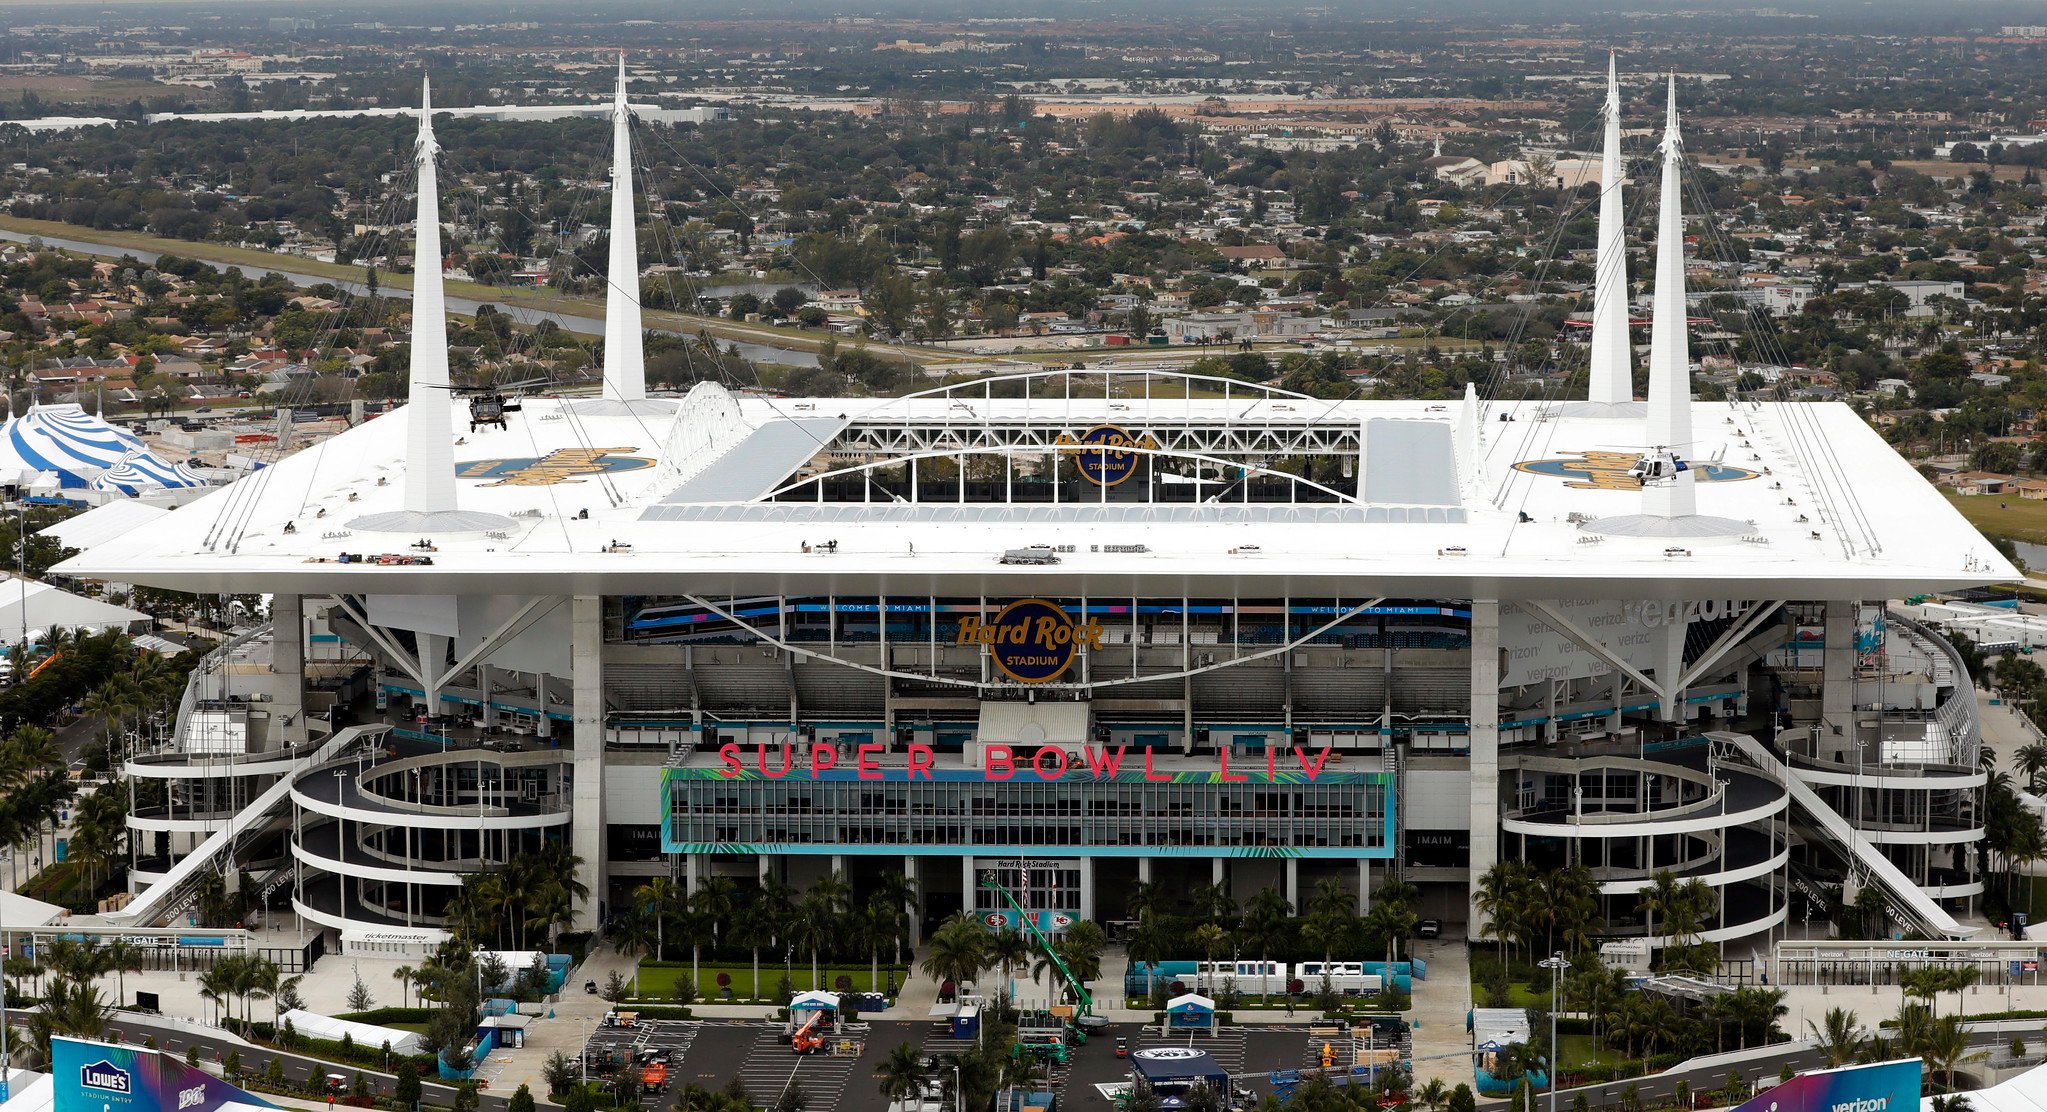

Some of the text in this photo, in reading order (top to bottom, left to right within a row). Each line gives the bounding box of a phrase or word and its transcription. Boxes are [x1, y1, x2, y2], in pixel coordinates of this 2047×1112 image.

[1055, 434, 1106, 455] Hard
[1088, 463, 1125, 471] STADIUM
[820, 604, 870, 612] WLCOME
[894, 604, 926, 612] MIAMI
[957, 616, 1104, 651] Hard Rock
[1510, 646, 1538, 660] rizon
[1006, 656, 1058, 666] STADIUM
[1526, 665, 1568, 681] verizon
[719, 742, 1331, 782] SUPER BOWL LIV
[997, 860, 1014, 868] Hard
[1031, 860, 1060, 868] Stadium
[1794, 878, 1827, 912] 200 LEVEL
[164, 907, 180, 923] 300
[133, 936, 159, 945] GATE
[364, 932, 429, 941] ticketmaster
[1886, 950, 1930, 958] NE GATE
[86, 1068, 126, 1090] LOWE'S
[81, 1091, 133, 1104] STADIUM ENTRY
[1831, 1097, 1887, 1112] verizon
